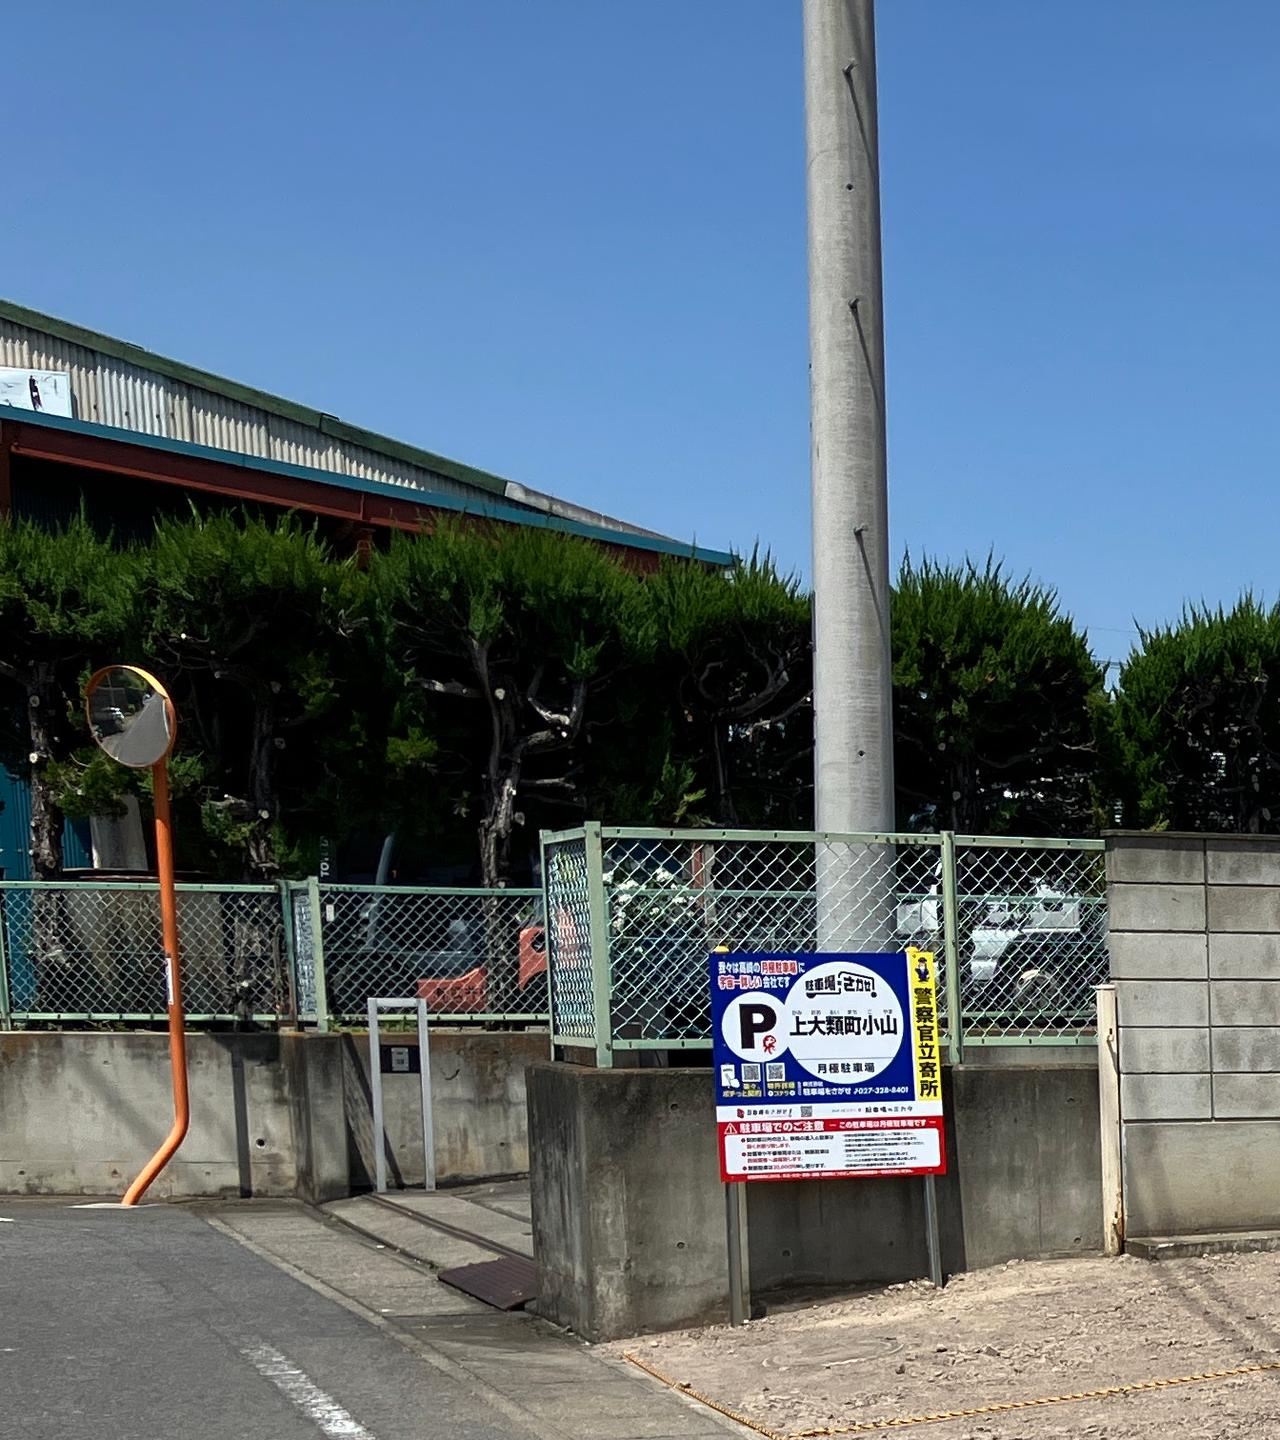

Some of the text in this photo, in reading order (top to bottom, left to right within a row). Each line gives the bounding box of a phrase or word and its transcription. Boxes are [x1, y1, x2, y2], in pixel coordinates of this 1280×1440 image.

[739, 1003, 777, 1050] P
[789, 1014, 898, 1036] 上大類町小山
[914, 987, 938, 1097] 警察官立寄所
[817, 1062, 875, 1074] 月極駐車場
[740, 1120, 825, 1134] 駐車場でのご注意
